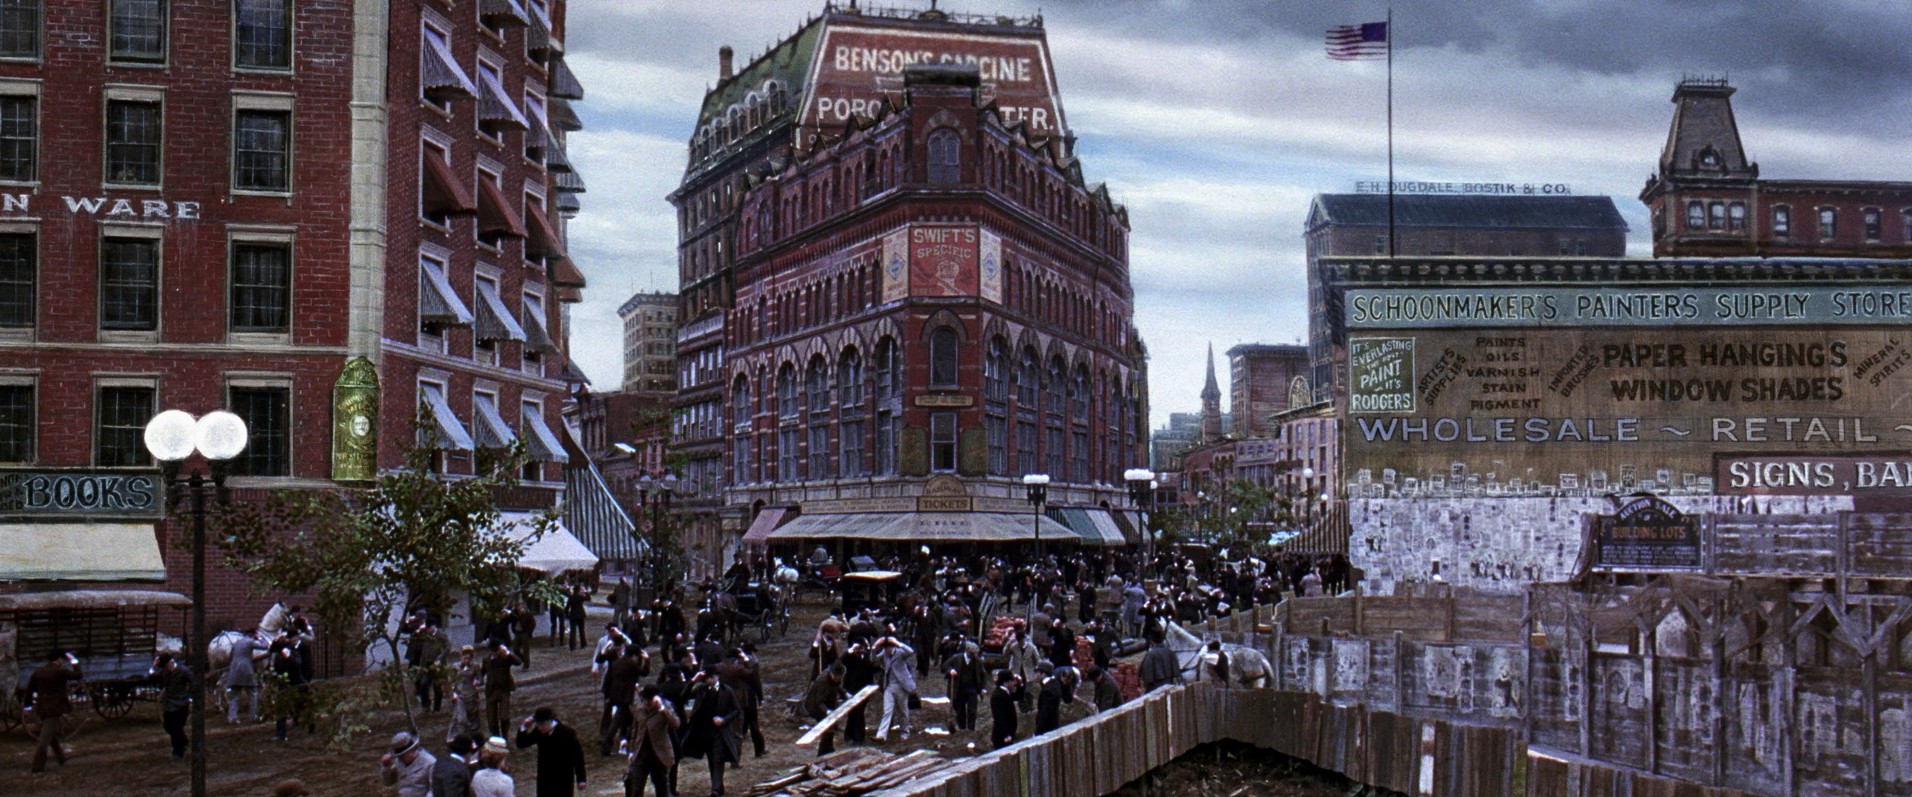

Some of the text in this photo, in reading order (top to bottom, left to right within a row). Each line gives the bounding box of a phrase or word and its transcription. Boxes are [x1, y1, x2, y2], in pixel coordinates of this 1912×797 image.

[818, 97, 882, 120] PORO
[1464, 182, 1516, 194] BOSTIK
[1523, 183, 1535, 195] &
[61, 195, 200, 220] WARE
[913, 228, 975, 243] SWIFT'S
[916, 244, 972, 259] SPECIFIC
[1353, 292, 1912, 322] SCHOONMAKER'S PAINTERS SUPPLY STORE
[1352, 340, 1412, 367] EVERLASTING
[1476, 337, 1526, 347] PAINTS
[1486, 352, 1519, 362] OILS
[1603, 341, 1848, 369] PAPER HANGINGS
[1853, 339, 1899, 379] MINERAL
[1360, 359, 1402, 389] PAINT
[1425, 354, 1467, 406] SUPPLIES
[1466, 367, 1540, 378] VARNISH
[1548, 345, 1589, 392] IMPORTED
[1561, 354, 1600, 398] BRUSHES
[1870, 350, 1910, 387] SPIRITS
[1385, 379, 1402, 390] IT'S
[1482, 383, 1526, 394] STAIN
[1610, 377, 1843, 401] WINDOW SHADES
[1352, 393, 1411, 410] RODGERS
[1470, 398, 1541, 410] PIGMENT
[1357, 417, 1878, 442] WHOLESALE RETAIL
[23, 475, 153, 509] BOOKS
[923, 500, 968, 510] TICKETS
[1612, 526, 1686, 539] BUILDING LOTS
